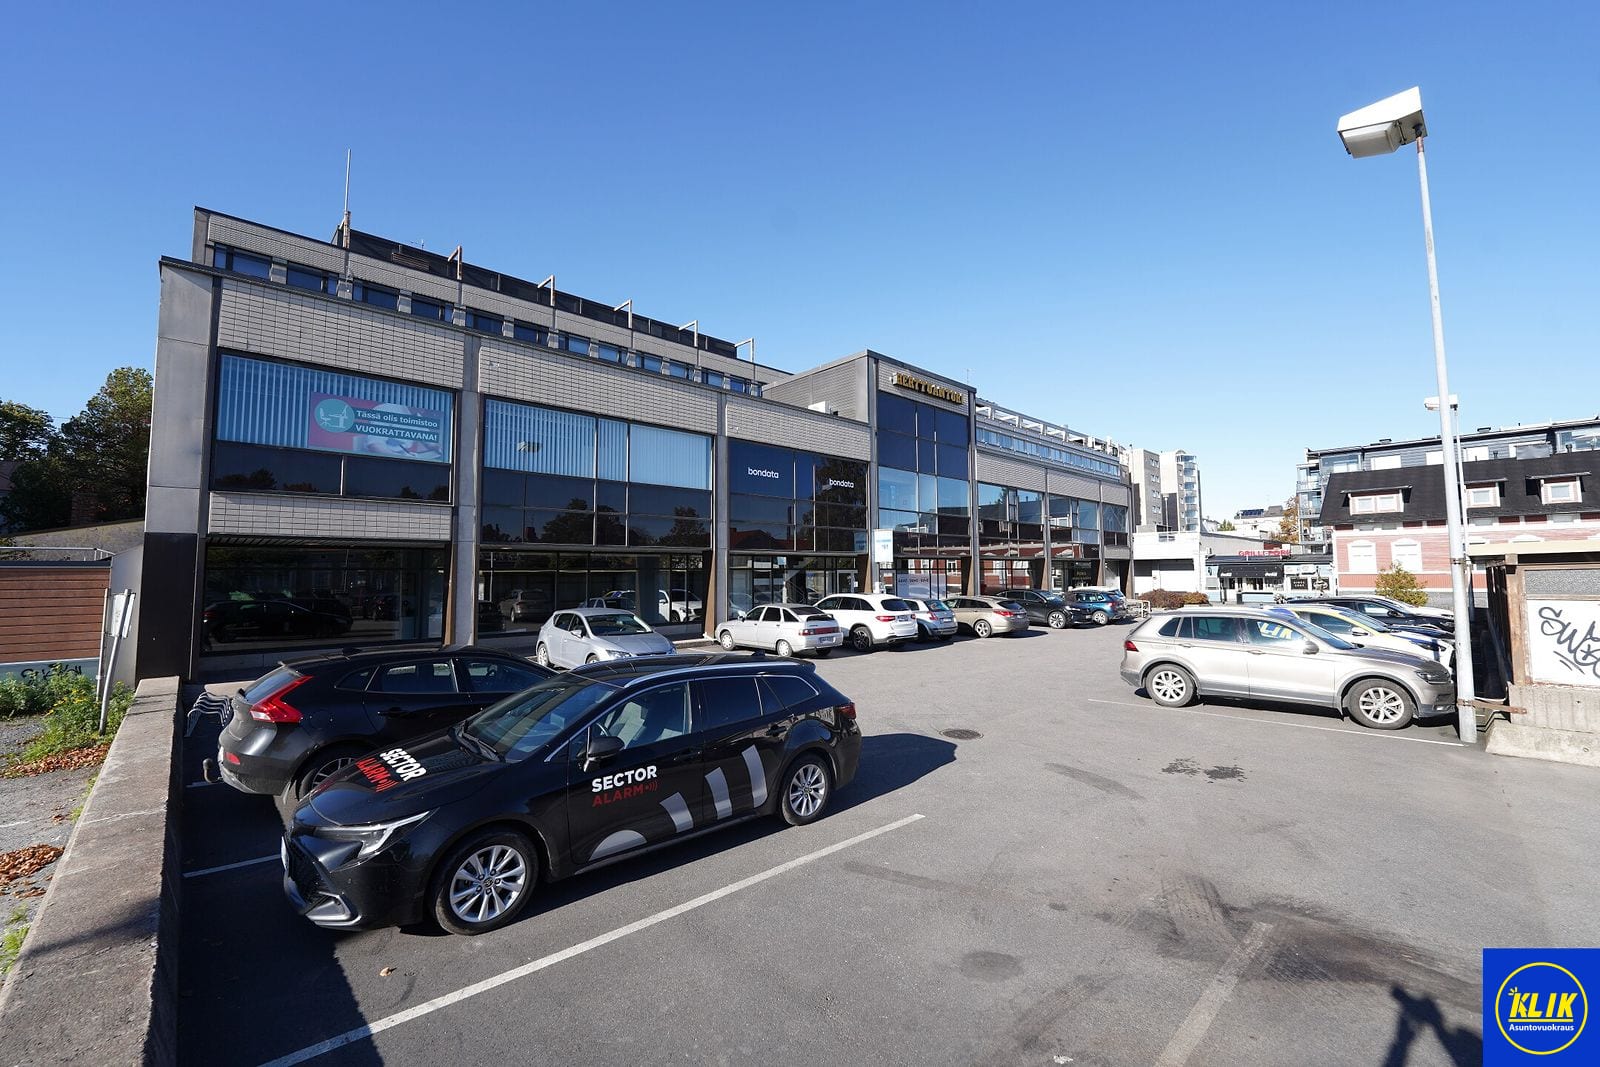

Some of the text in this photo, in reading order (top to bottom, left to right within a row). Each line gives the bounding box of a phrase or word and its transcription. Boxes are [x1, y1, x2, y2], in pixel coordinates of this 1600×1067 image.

[383, 414, 398, 423] olis
[400, 415, 438, 428] toimistoo
[355, 424, 438, 441] VUOKRATTAVANA!
[747, 466, 780, 479] bondata
[829, 478, 855, 489] bondata
[355, 757, 391, 783] ALARM
[380, 748, 427, 782] SECTOR
[591, 765, 658, 793] SECTOR
[592, 783, 644, 808] ALARM
